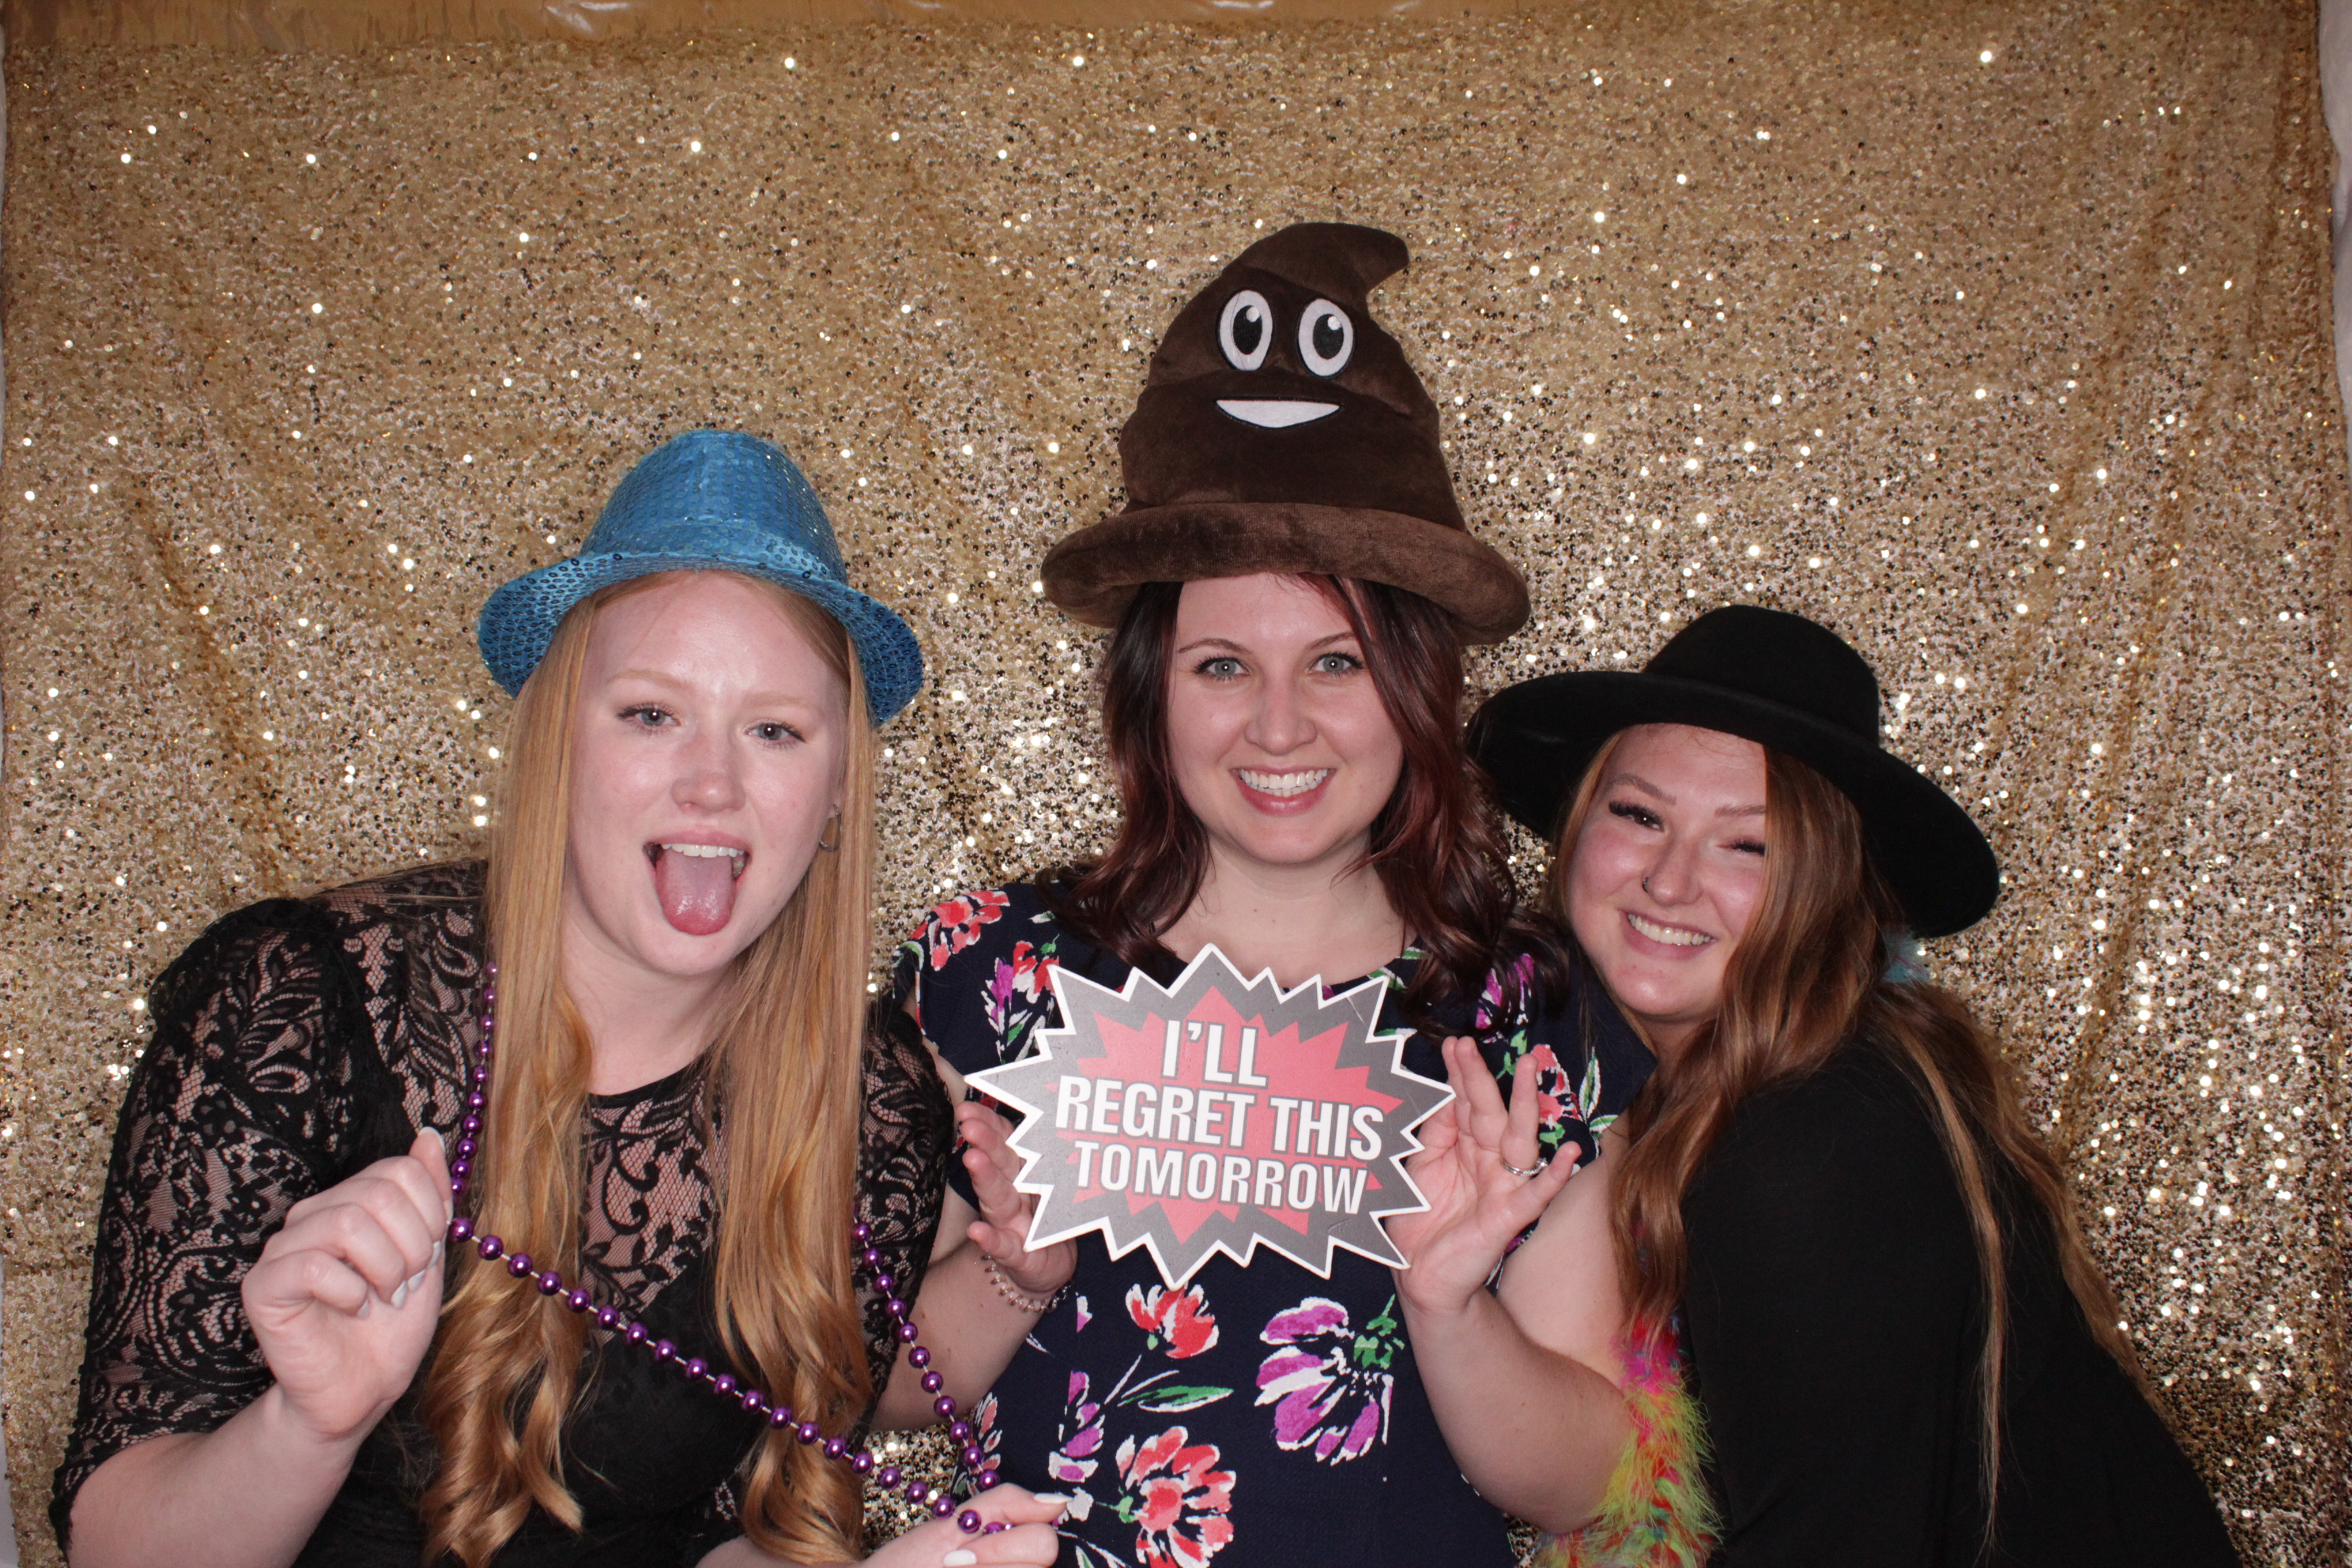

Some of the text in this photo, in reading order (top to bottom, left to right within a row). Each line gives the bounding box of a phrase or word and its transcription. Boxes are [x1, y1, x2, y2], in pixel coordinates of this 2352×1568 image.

[1162, 1019, 1268, 1088] I'LL
[1054, 1075, 1384, 1161] REGRET THIS
[1073, 1140, 1368, 1215] TOMORROW
